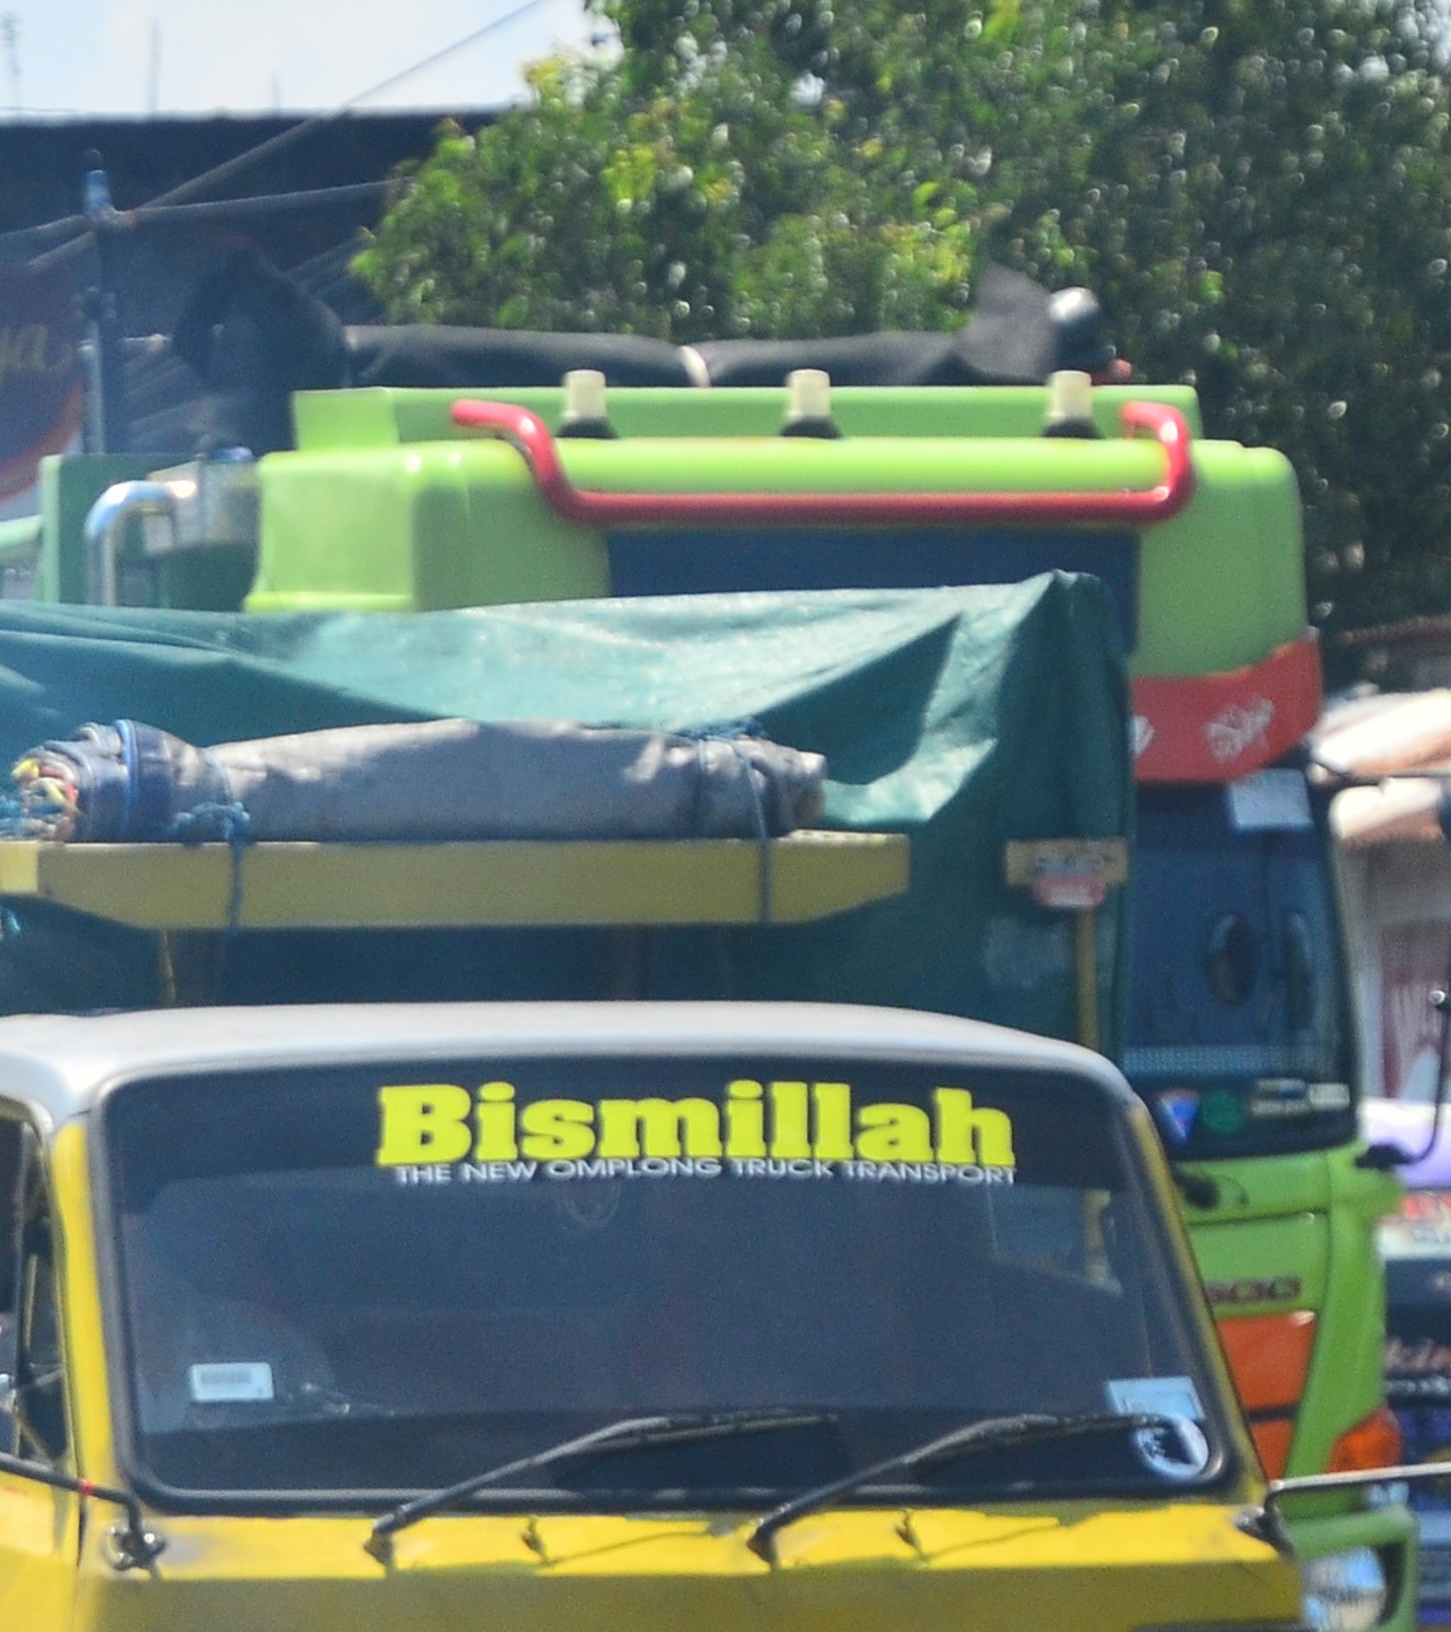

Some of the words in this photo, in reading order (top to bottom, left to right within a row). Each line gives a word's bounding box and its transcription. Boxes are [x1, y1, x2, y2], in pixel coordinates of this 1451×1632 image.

[378, 1080, 1016, 1167] Bismillah
[399, 1163, 450, 1184] THE
[463, 1160, 537, 1182] NEW
[549, 1157, 723, 1179] OMPLONG
[734, 1158, 833, 1179] TRUCK
[844, 1160, 1016, 1184] TRANSPORT
